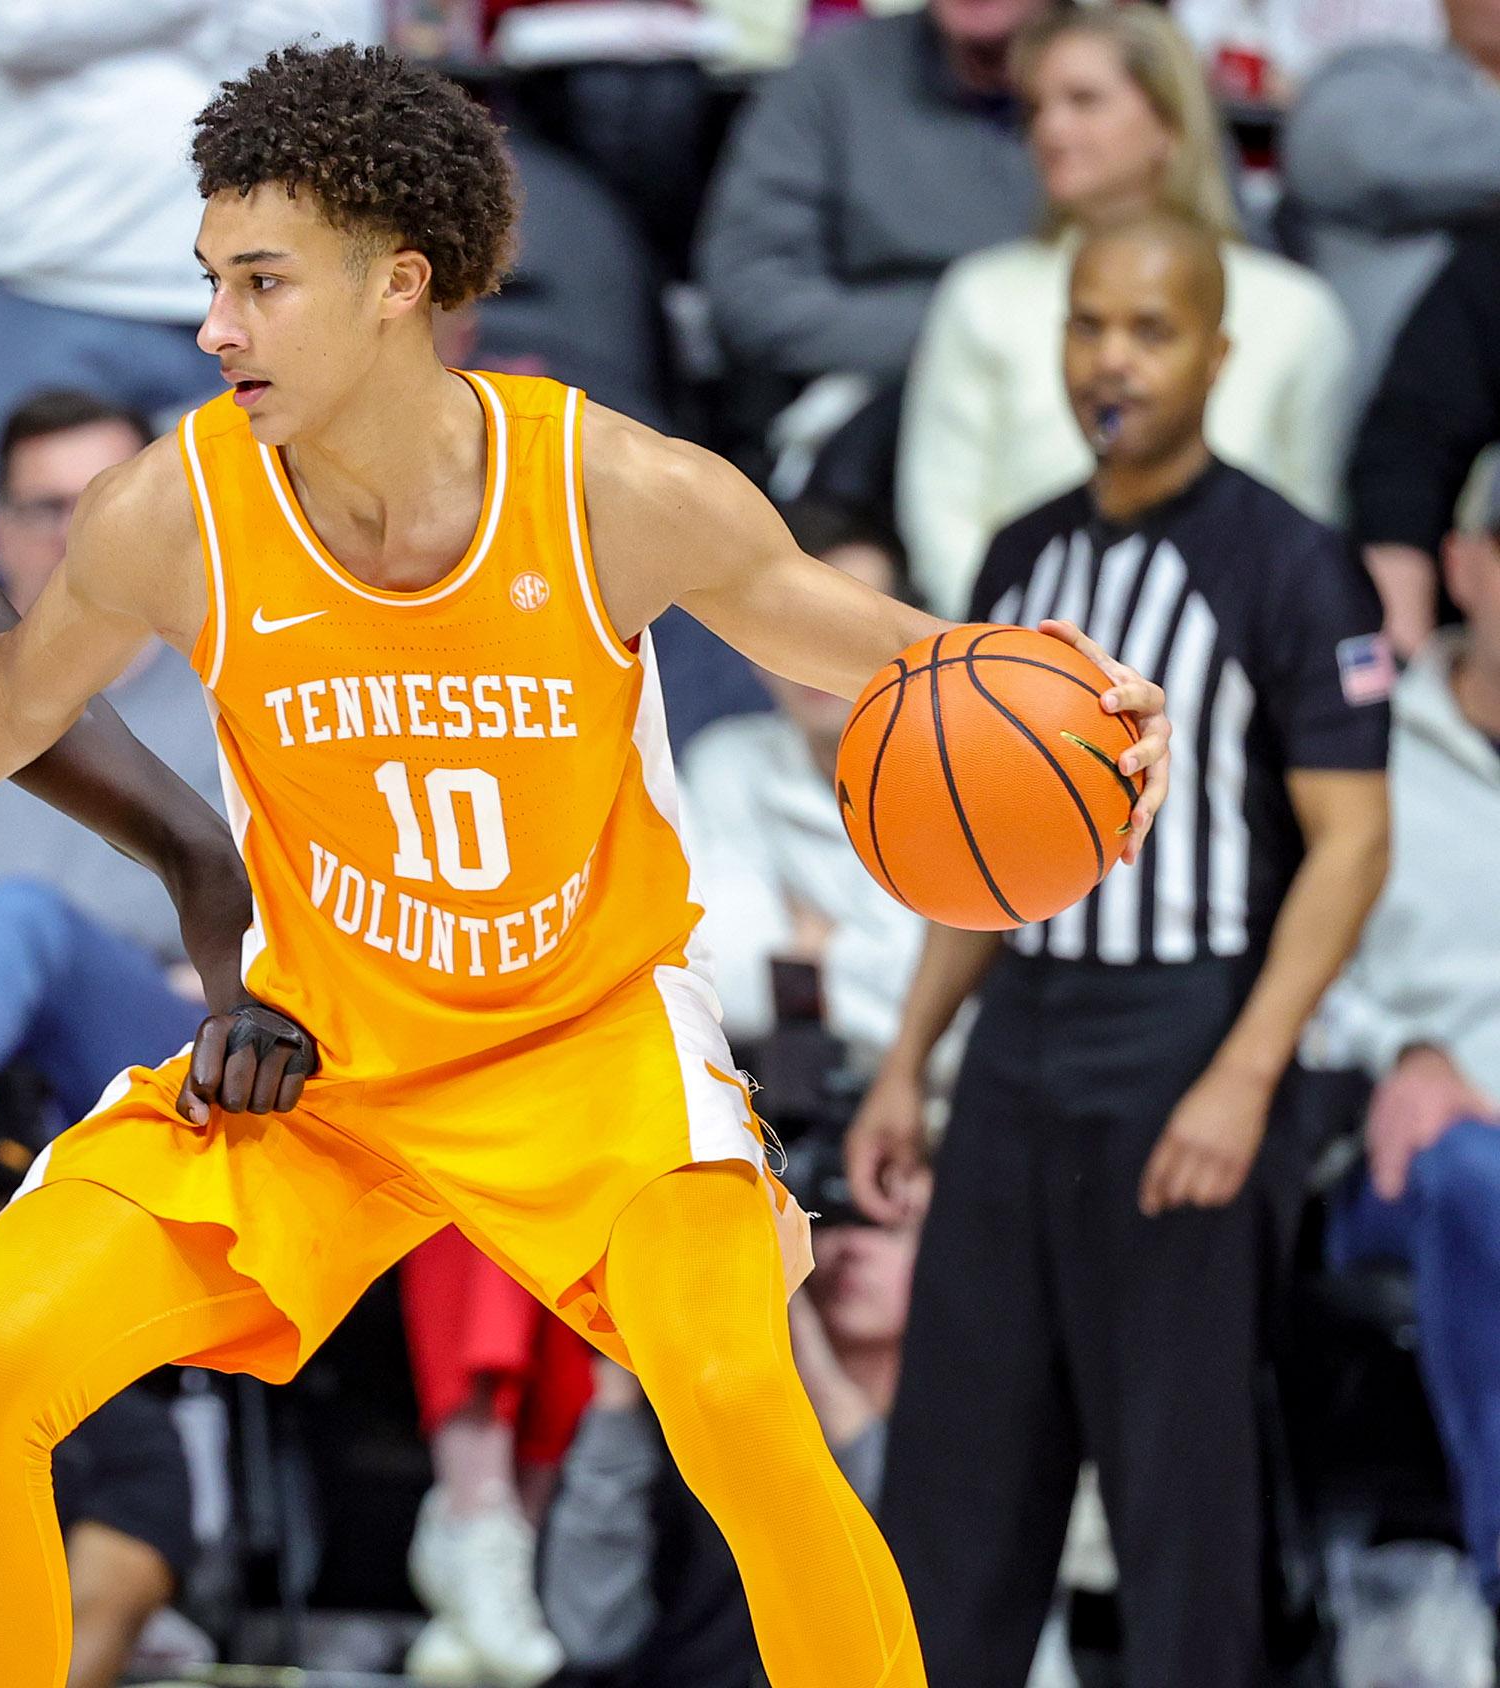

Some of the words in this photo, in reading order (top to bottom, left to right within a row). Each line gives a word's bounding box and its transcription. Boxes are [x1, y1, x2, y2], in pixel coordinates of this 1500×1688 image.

[512, 574, 547, 610] SEC
[264, 674, 579, 747] TENNESSEE
[373, 760, 512, 891] 10
